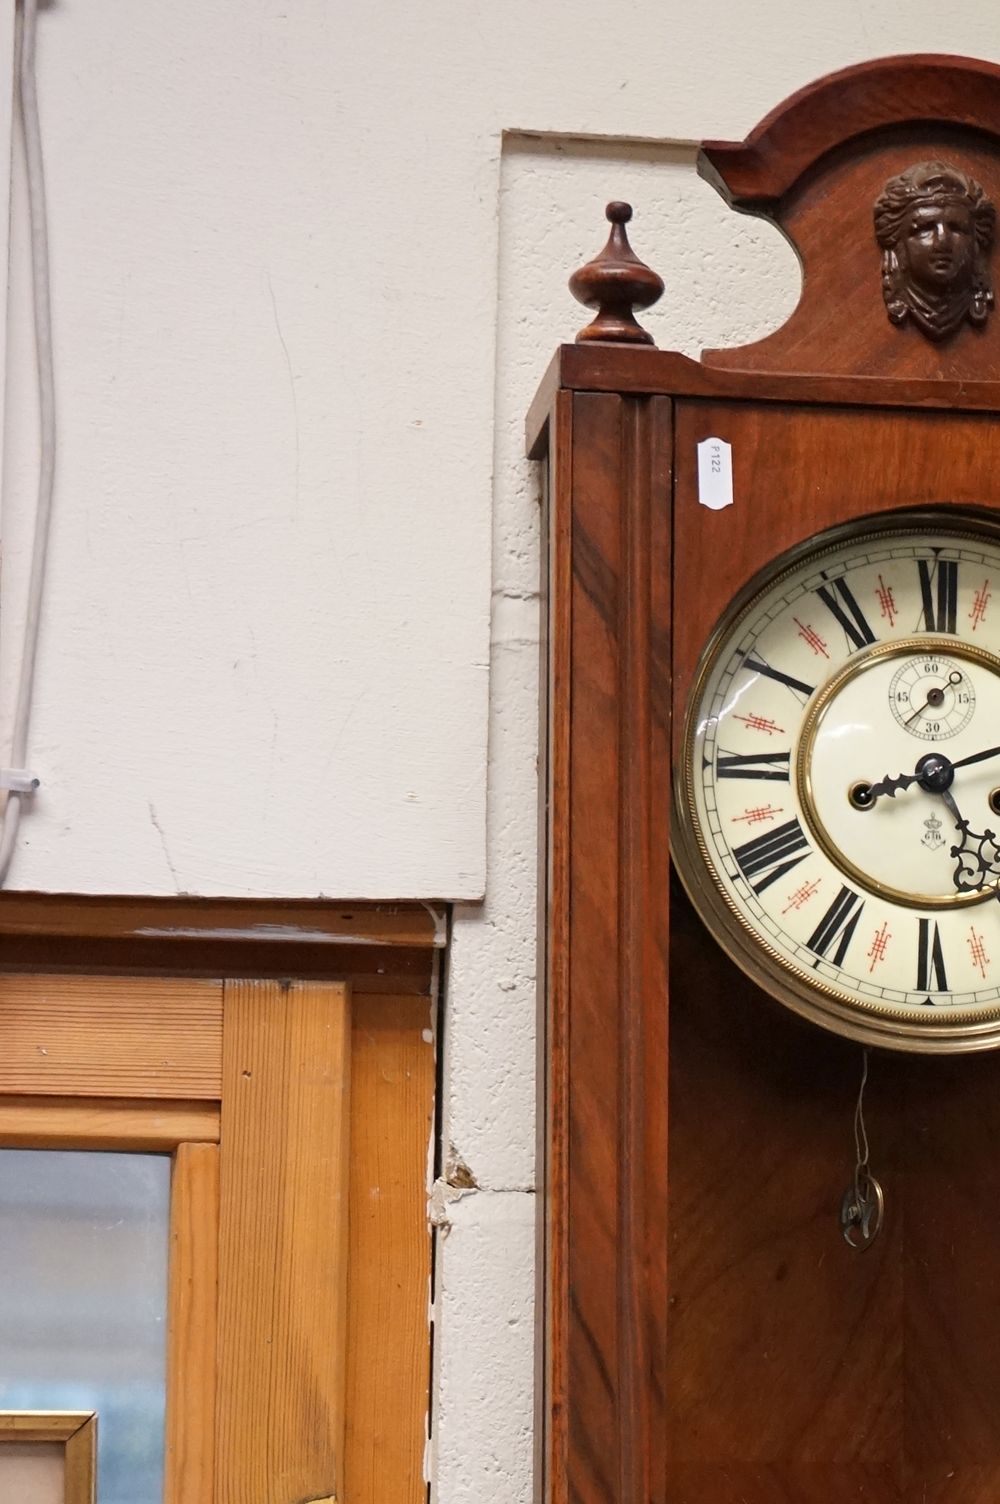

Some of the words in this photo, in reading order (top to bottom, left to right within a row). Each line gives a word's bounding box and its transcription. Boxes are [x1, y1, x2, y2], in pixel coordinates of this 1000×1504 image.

[710, 446, 721, 473] P122
[811, 575, 881, 656] XI
[912, 559, 960, 635] XII
[743, 648, 818, 709] X
[924, 663, 939, 673] 60
[896, 692, 909, 703] 45
[958, 693, 970, 704] 15
[925, 723, 940, 733] 30
[717, 747, 791, 783] IX
[732, 815, 814, 898] VIII
[802, 883, 866, 969] VII
[913, 917, 952, 992] VI
